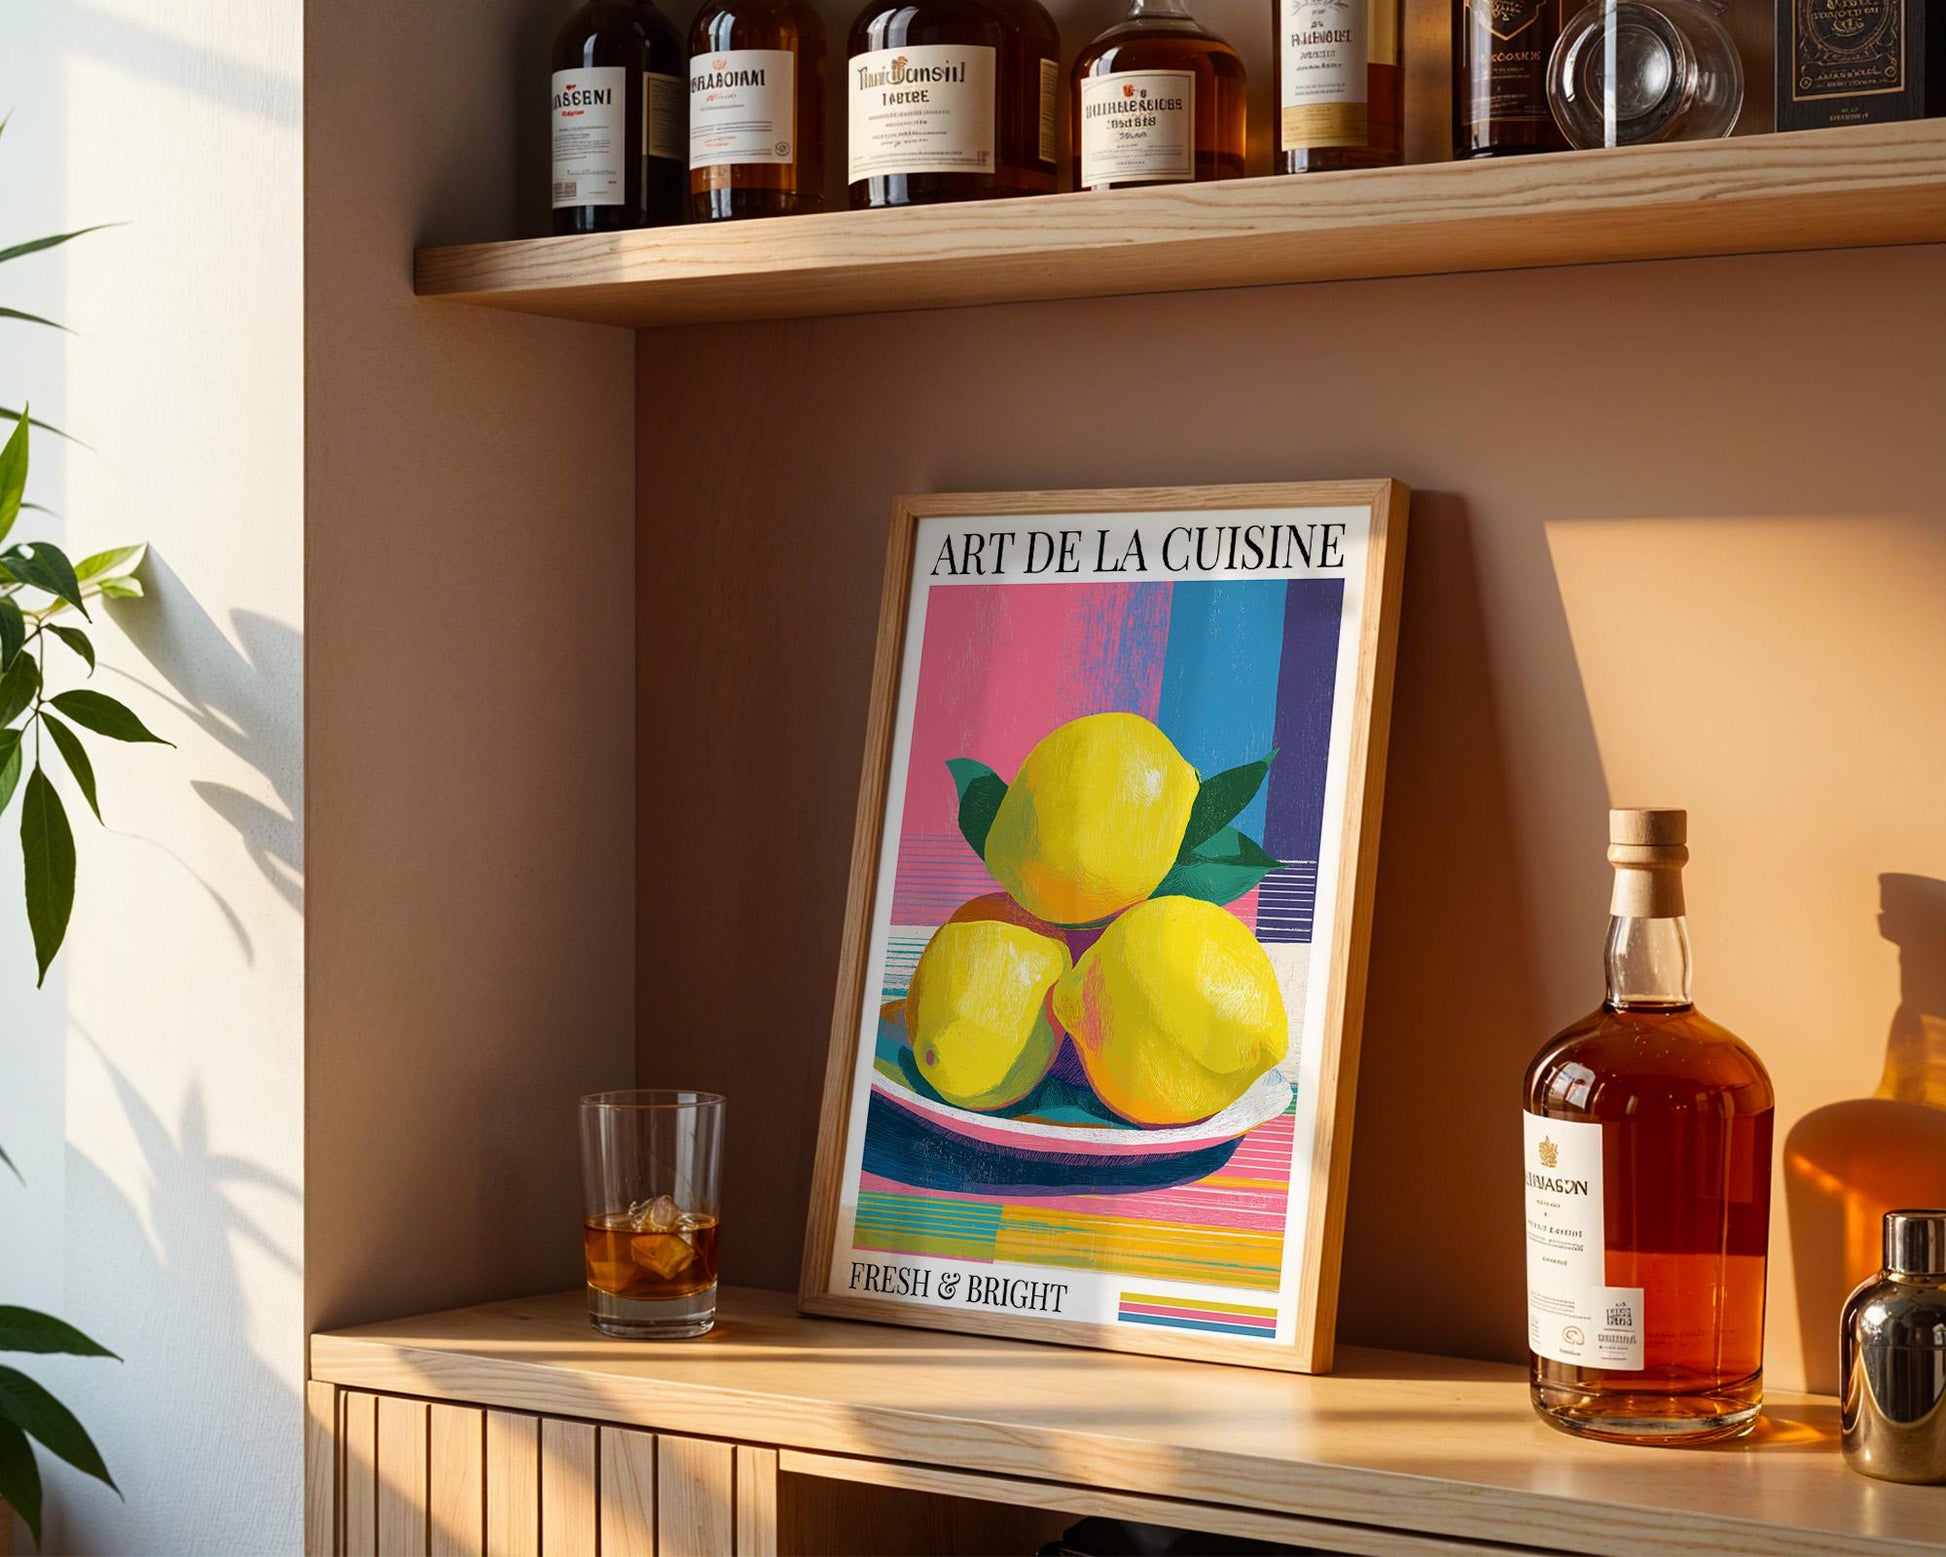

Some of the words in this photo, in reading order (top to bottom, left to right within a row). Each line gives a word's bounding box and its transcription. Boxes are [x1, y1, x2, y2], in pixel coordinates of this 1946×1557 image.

[930, 532, 1015, 576] ART
[1023, 530, 1082, 574] DE
[1092, 529, 1148, 573] LA
[1161, 523, 1346, 572] CUISINE
[849, 1261, 931, 1297] FRESH
[937, 1272, 961, 1300] &
[966, 1274, 1068, 1313] BRIGHT
